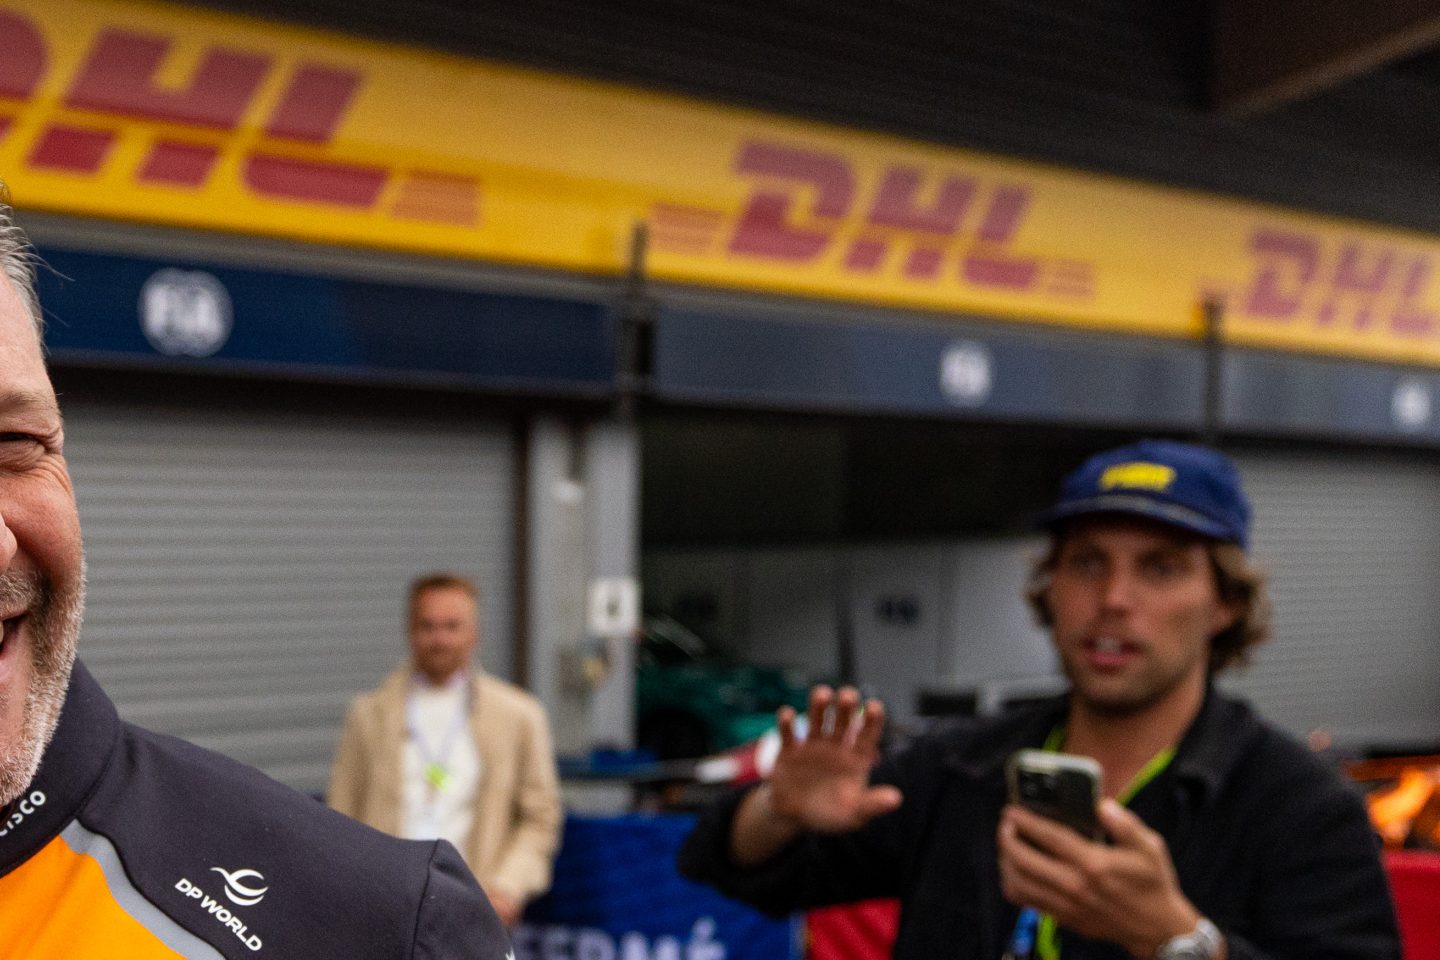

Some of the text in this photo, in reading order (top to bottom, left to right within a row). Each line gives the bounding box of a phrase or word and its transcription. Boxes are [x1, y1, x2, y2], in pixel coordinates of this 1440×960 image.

[726, 138, 1040, 291] DHL
[1246, 227, 1436, 336] DHL
[175, 878, 262, 952] DP WORLD
